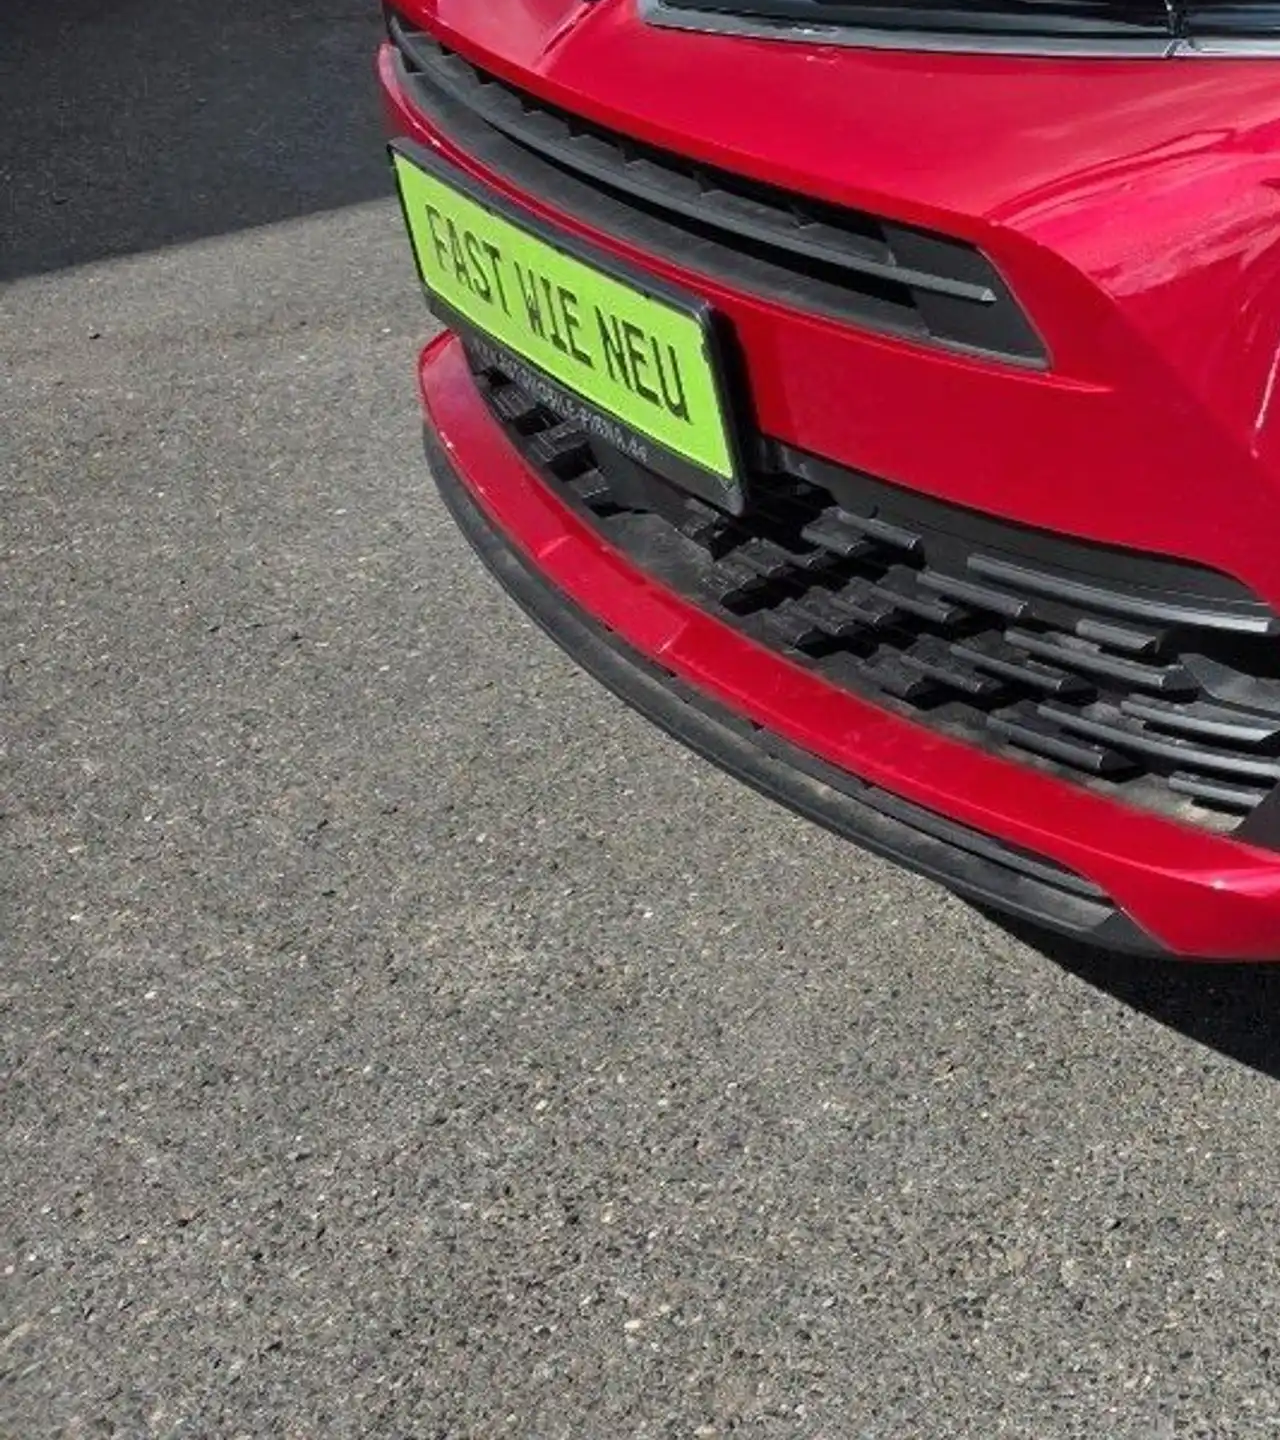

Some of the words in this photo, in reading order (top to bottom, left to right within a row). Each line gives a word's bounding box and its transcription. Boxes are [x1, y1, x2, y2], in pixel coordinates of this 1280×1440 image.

[425, 202, 512, 318] FAST
[513, 260, 596, 372] WIE
[594, 304, 694, 426] NEU
